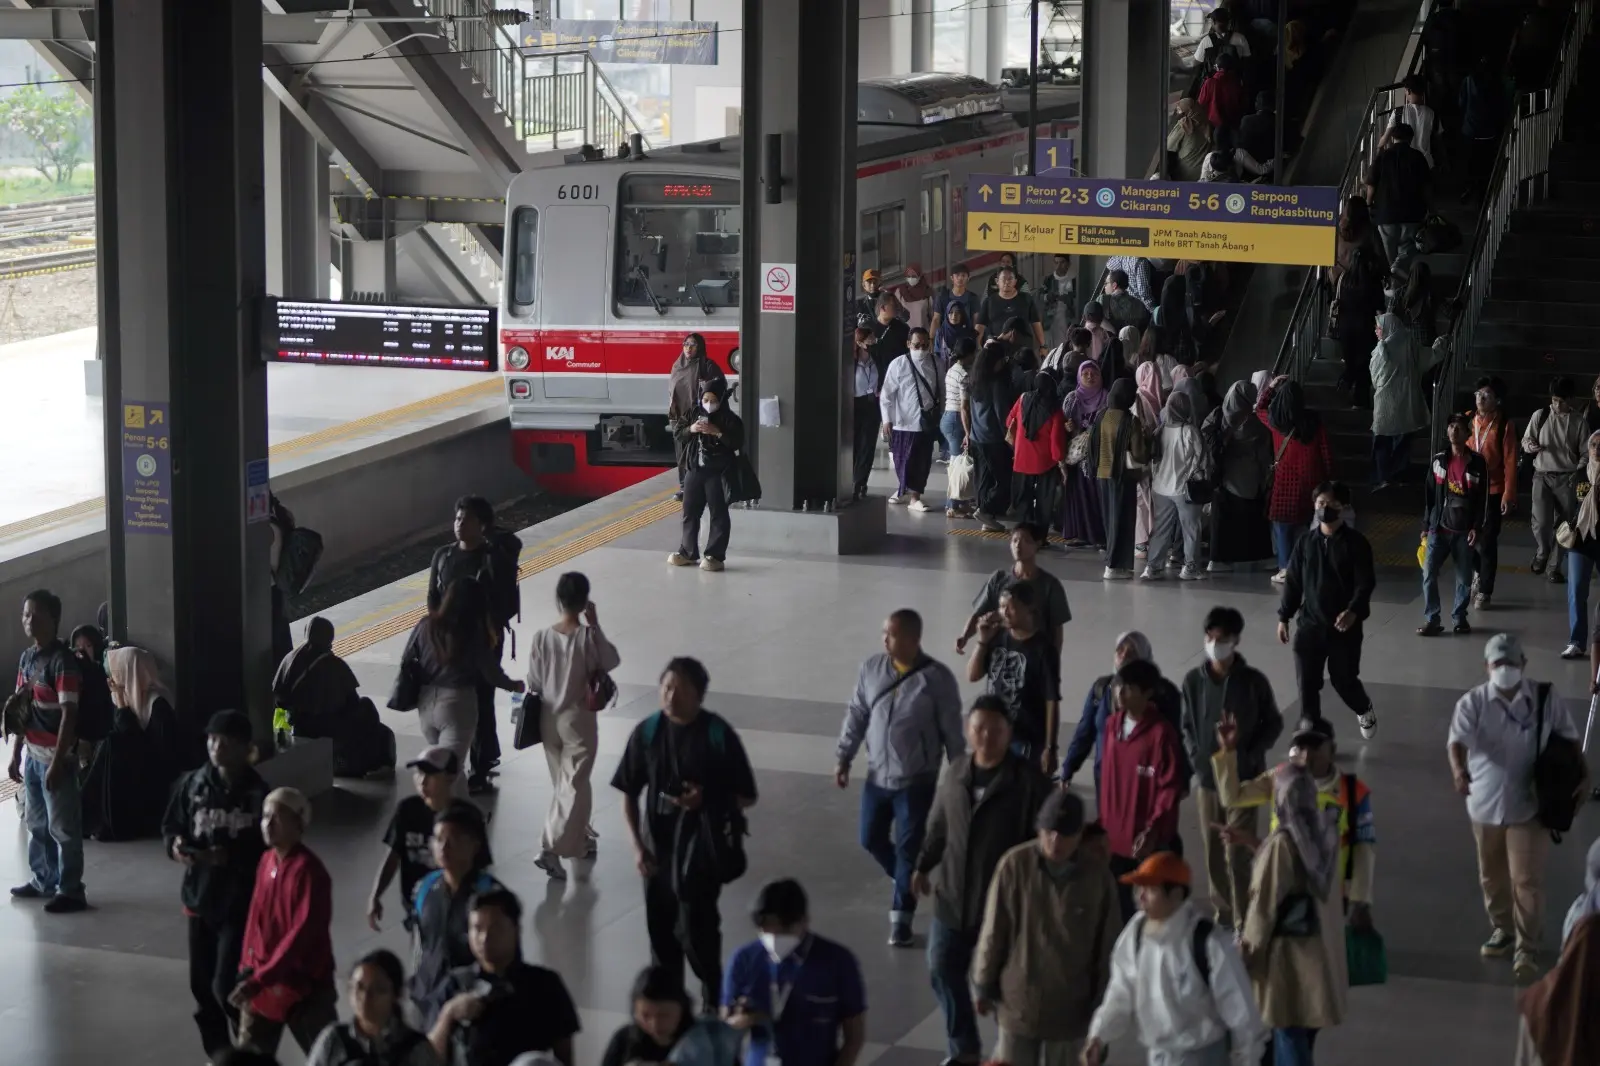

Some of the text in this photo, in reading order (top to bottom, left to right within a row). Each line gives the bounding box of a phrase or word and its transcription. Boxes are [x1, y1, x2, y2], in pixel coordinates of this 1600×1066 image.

[1047, 146, 1057, 168] 1
[558, 184, 599, 200] 6001
[1026, 185, 1057, 196] Peron
[1121, 185, 1180, 199] Manggarai
[1025, 197, 1054, 205] Platform
[1251, 190, 1298, 204] Serpong
[1120, 200, 1171, 214] Cikarang
[1251, 205, 1334, 221] Rangkasbitung
[1024, 224, 1055, 234] Keluar
[1065, 227, 1074, 241] E
[1081, 227, 1116, 236] Hall Atas
[1153, 229, 1228, 241] JPM Tanah Abang
[1081, 235, 1142, 246] Bangunan Lama
[1153, 239, 1175, 248] Halte
[1177, 240, 1193, 249] BRT
[1195, 240, 1220, 249] Tanah
[1222, 242, 1249, 251] Abang
[546, 346, 575, 360] KAI
[566, 360, 601, 368] Commuter
[124, 432, 146, 442] Peron
